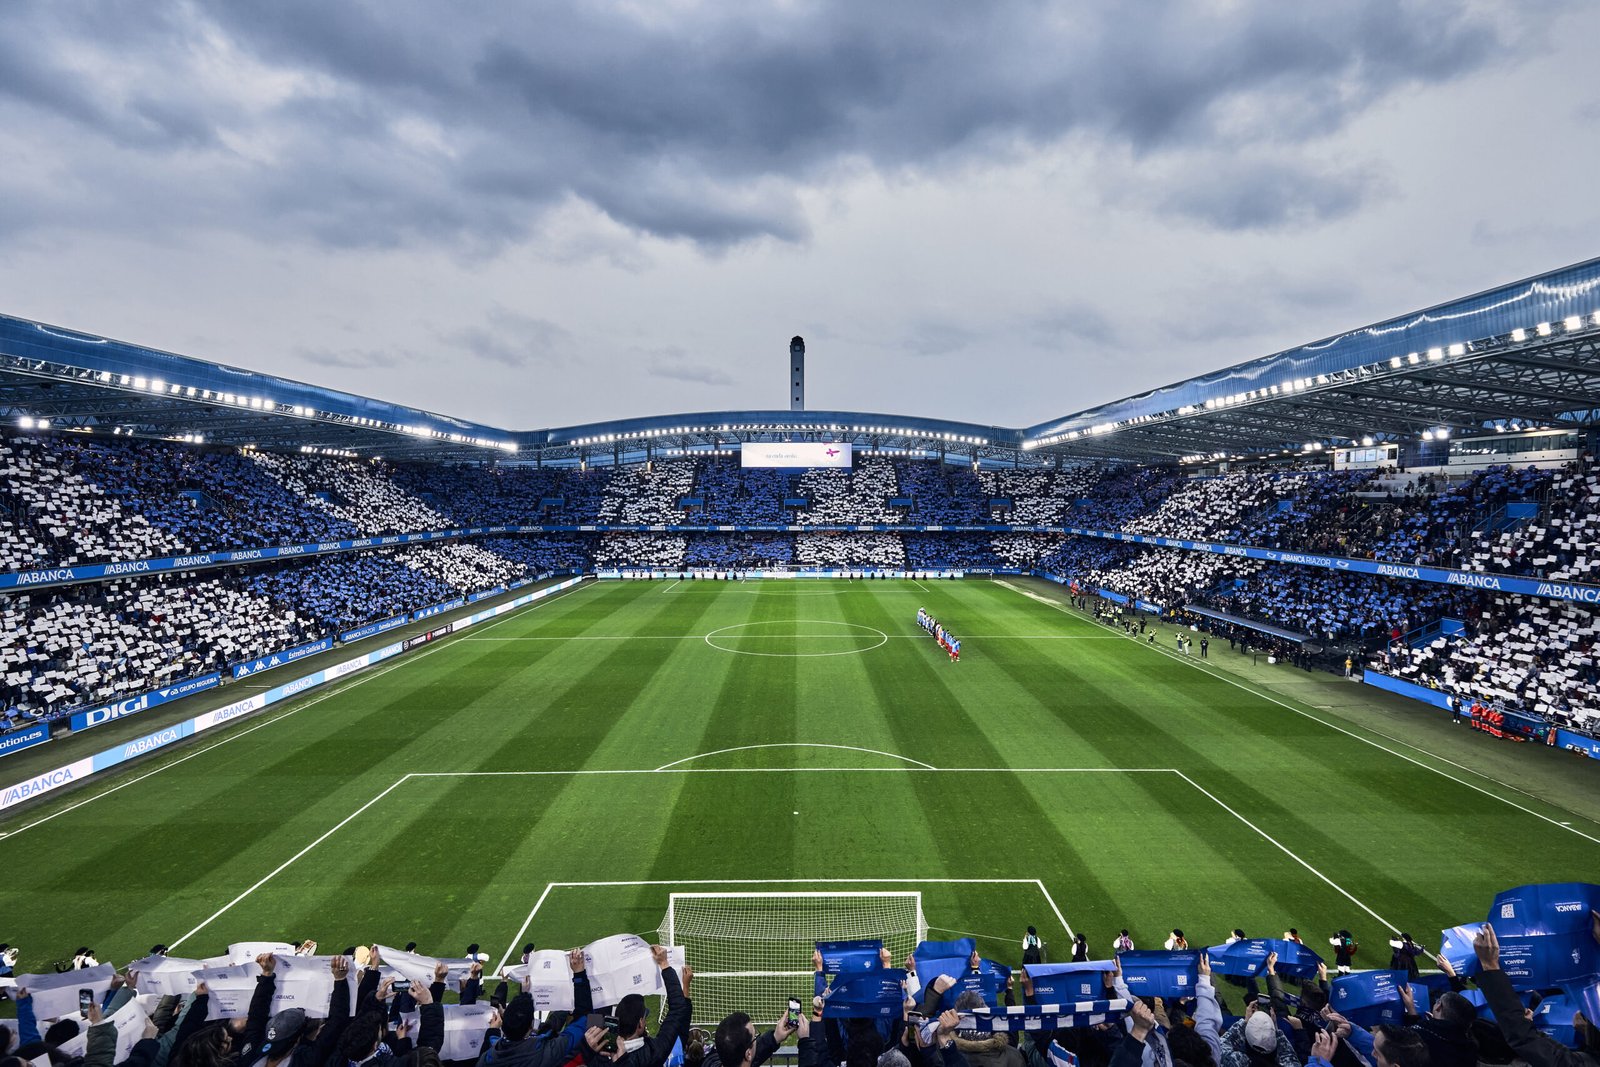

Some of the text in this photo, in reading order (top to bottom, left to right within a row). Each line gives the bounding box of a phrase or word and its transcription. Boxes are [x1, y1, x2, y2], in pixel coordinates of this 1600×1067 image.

[1306, 556, 1331, 566] RIAZOR
[288, 649, 305, 659] Estrella
[179, 684, 196, 693] GRUPO
[86, 695, 148, 727] DIGI
